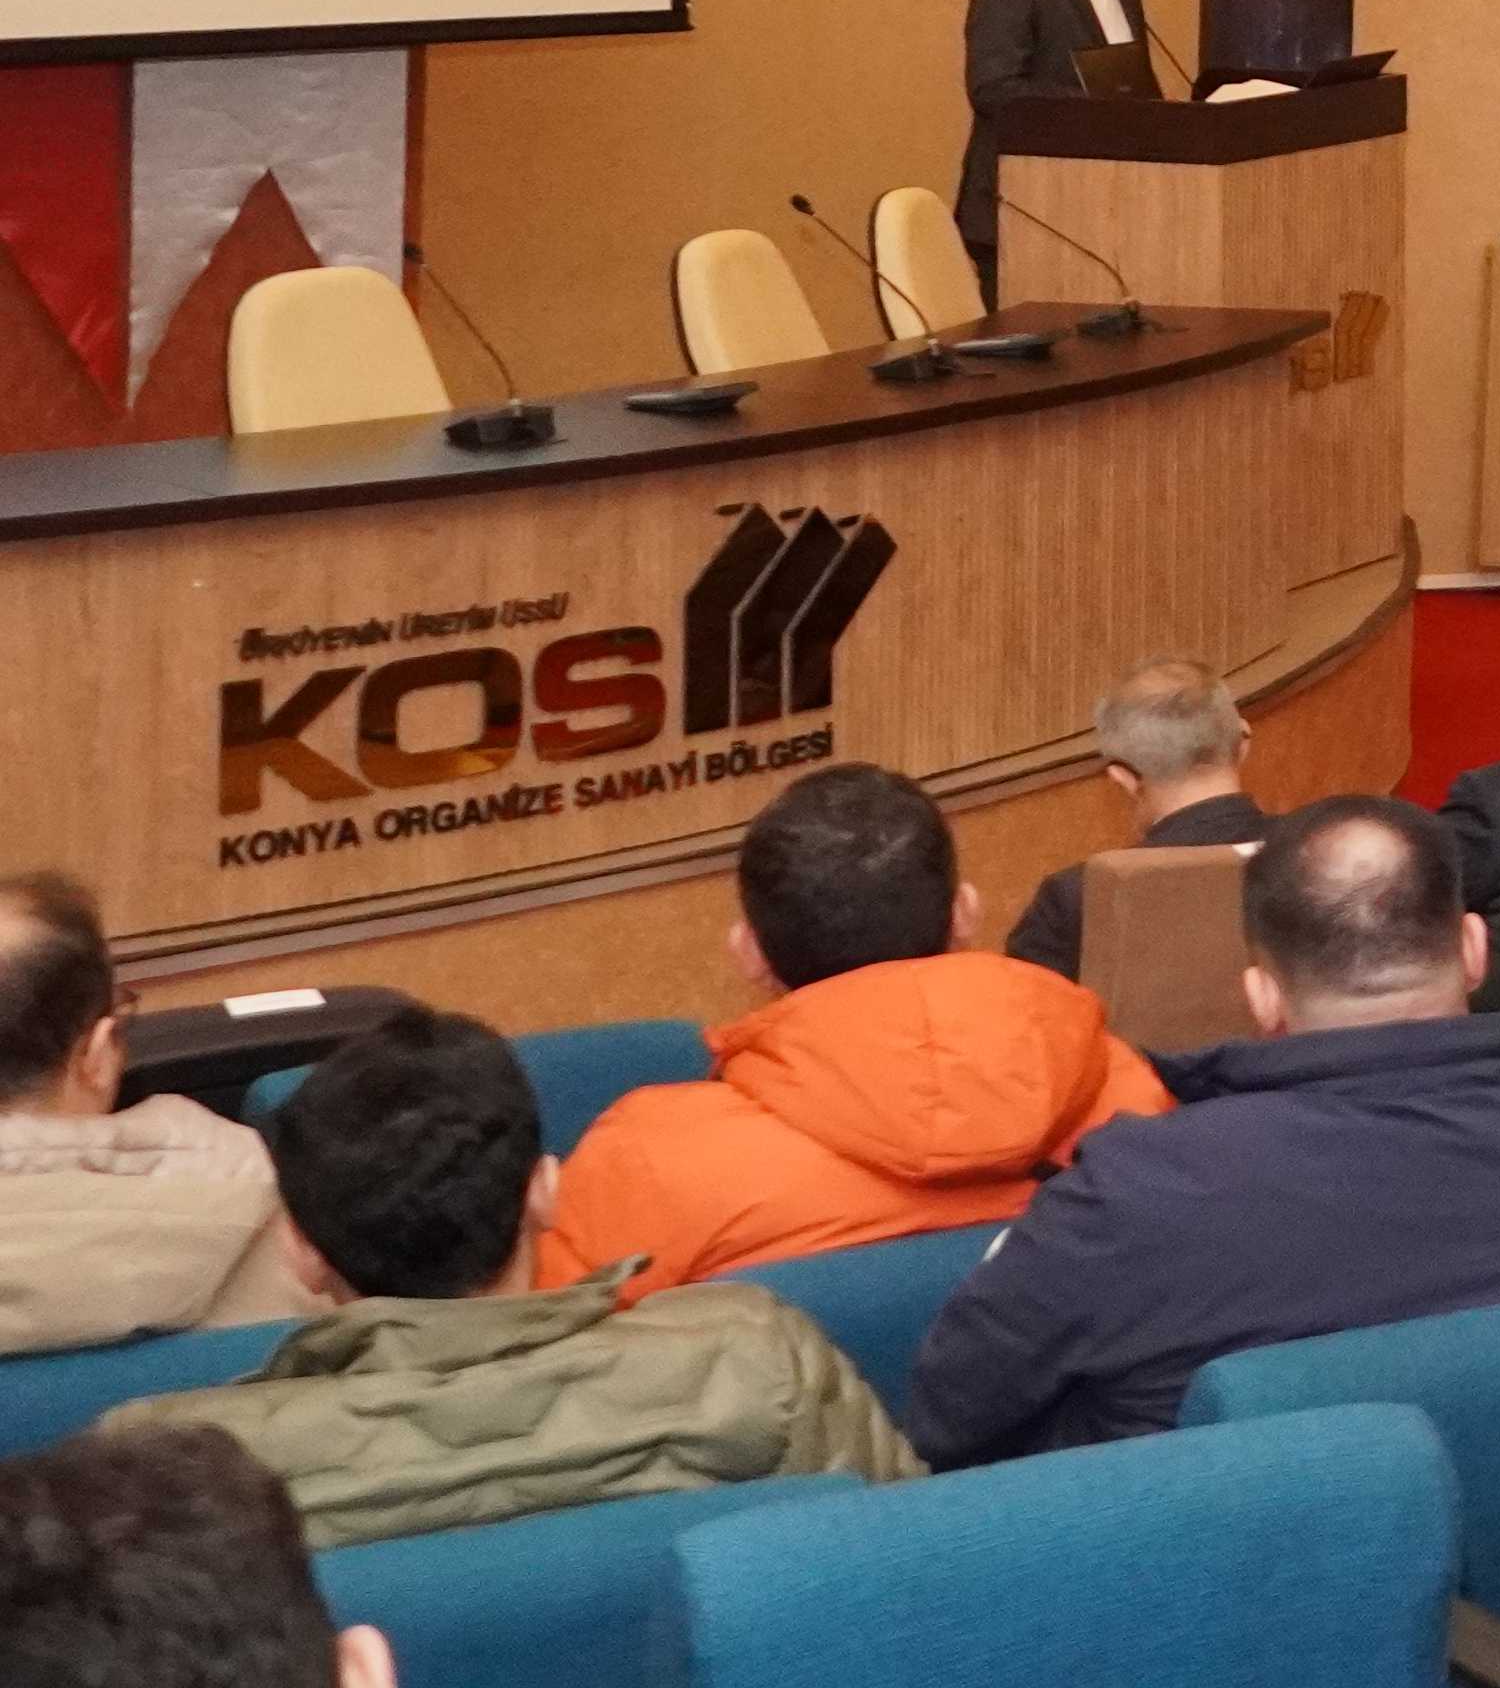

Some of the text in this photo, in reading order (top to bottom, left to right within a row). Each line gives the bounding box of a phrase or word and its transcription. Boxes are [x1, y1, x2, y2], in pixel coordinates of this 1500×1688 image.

[218, 721, 833, 869] KONYA ORGANİZE SANAYİ BÖLGESİ
[219, 625, 667, 817] KOS
